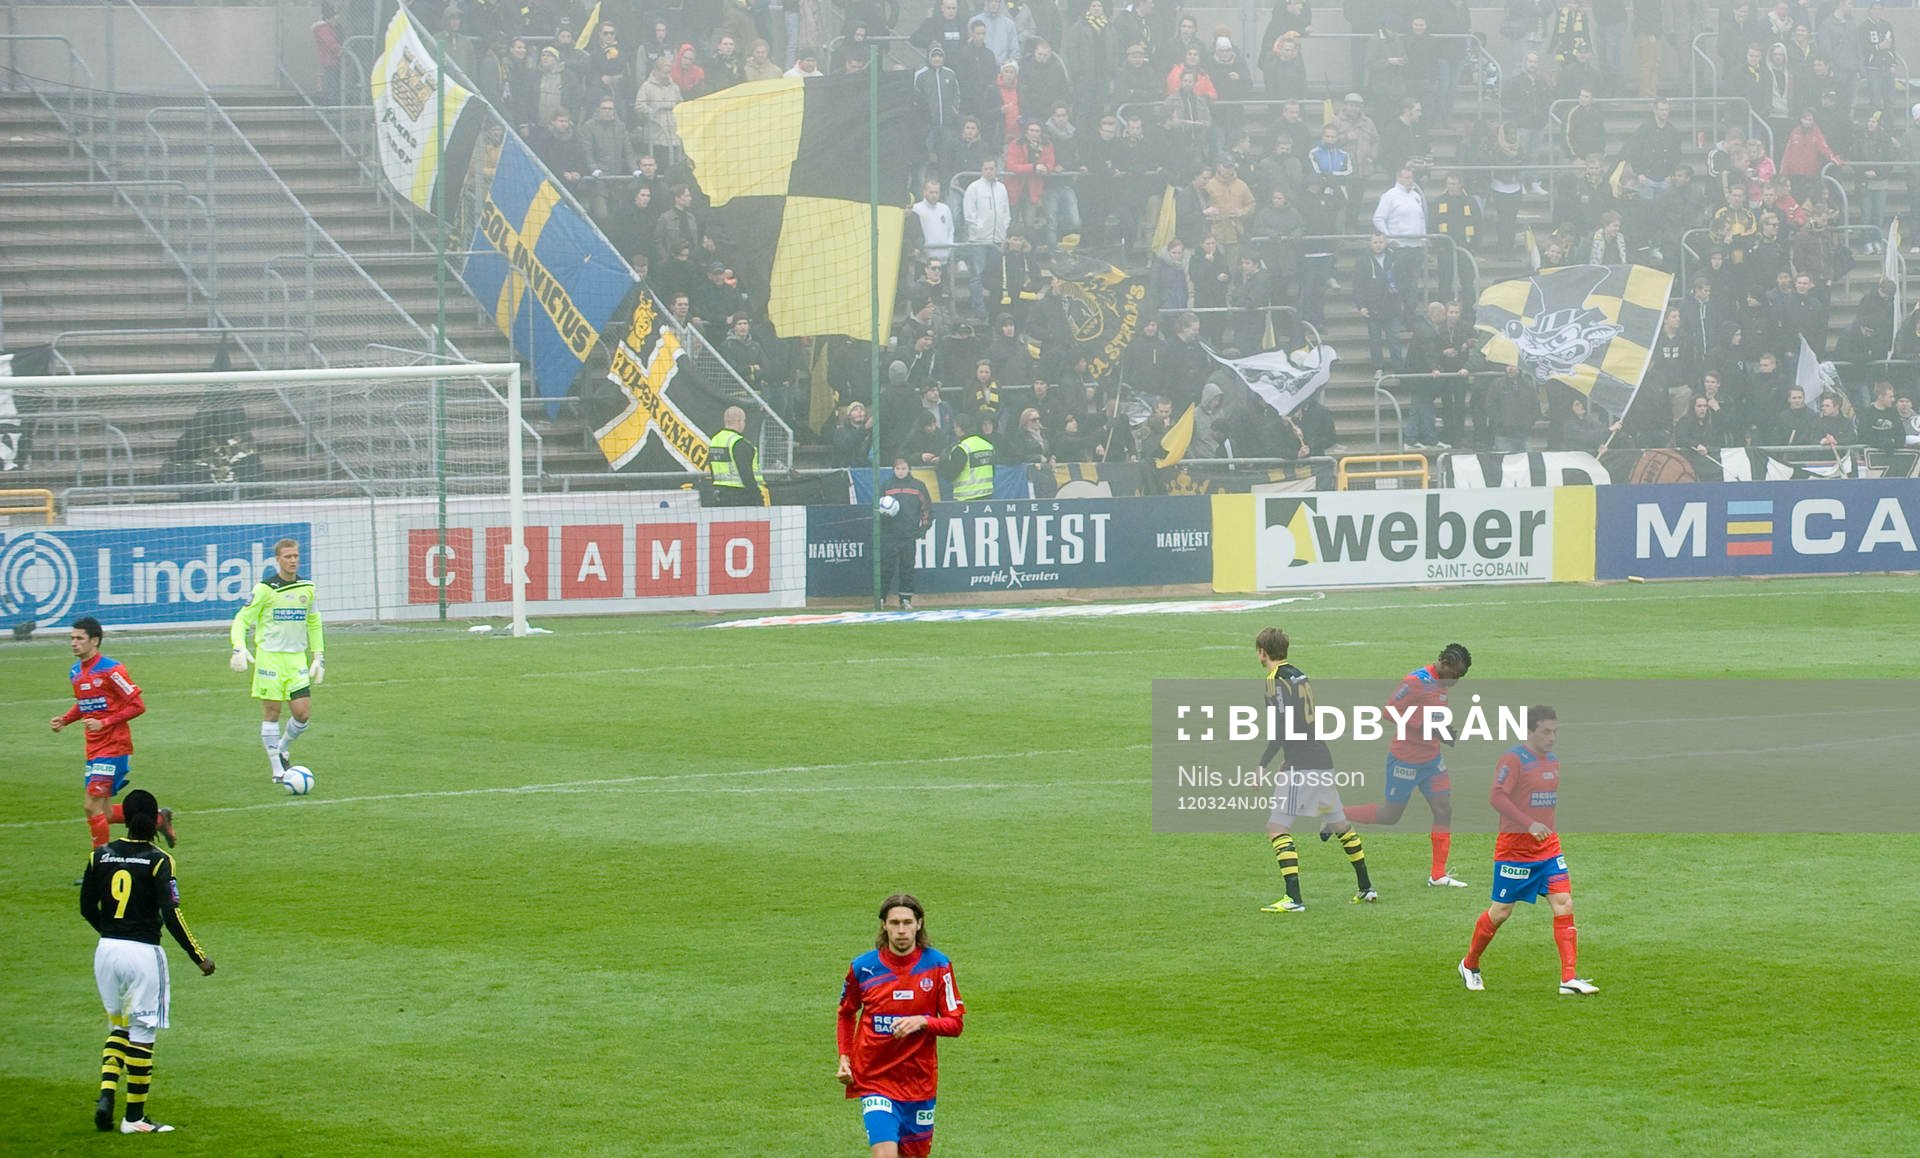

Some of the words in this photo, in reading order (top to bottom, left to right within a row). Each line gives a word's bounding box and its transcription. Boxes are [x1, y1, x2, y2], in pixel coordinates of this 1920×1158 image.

[480, 200, 510, 254] SOL
[512, 241, 592, 353] INVICTUS
[660, 410, 712, 472] GNAG
[963, 502, 1061, 514] JAMES
[914, 512, 1111, 569] HARVEST
[1156, 531, 1210, 548] HARVEST
[1312, 493, 1546, 564] weber
[1636, 498, 1918, 560] MECA
[808, 542, 865, 559] HARVEST
[970, 569, 1008, 587] profile
[1020, 570, 1059, 583] centers
[1426, 561, 1529, 579] SAINT-GOBAIN
[1501, 865, 1529, 877] SOLID
[111, 869, 133, 919] 9
